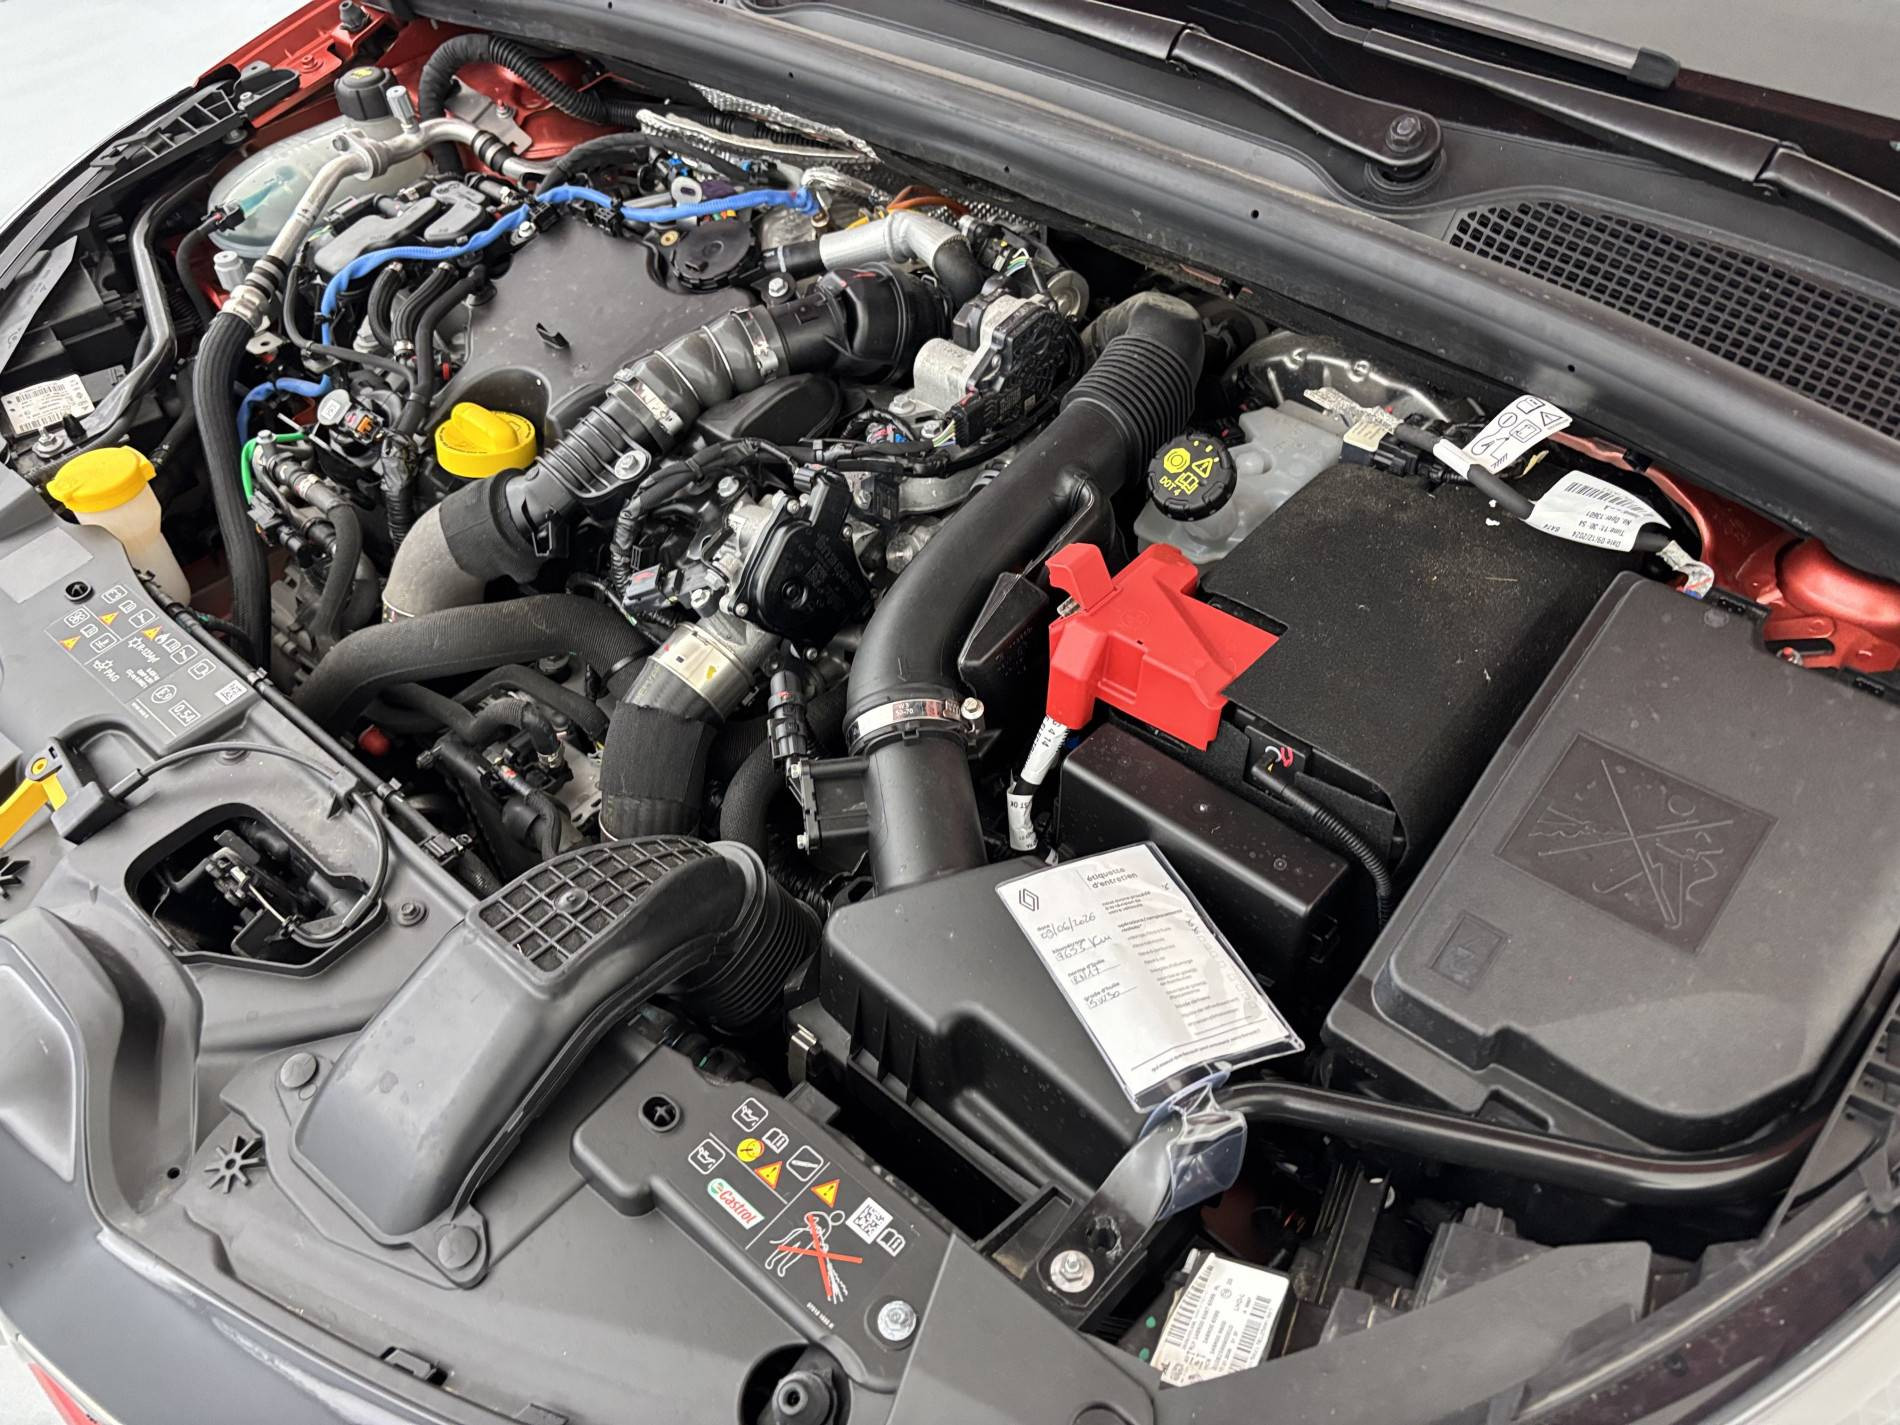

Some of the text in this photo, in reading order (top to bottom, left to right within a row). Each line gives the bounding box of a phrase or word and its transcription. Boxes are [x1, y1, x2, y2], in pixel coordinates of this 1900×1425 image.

[1159, 475, 1177, 491] DOT
[103, 666, 120, 682] PAG
[1092, 873, 1138, 889] d'entretien
[718, 1189, 758, 1225] Castrol
